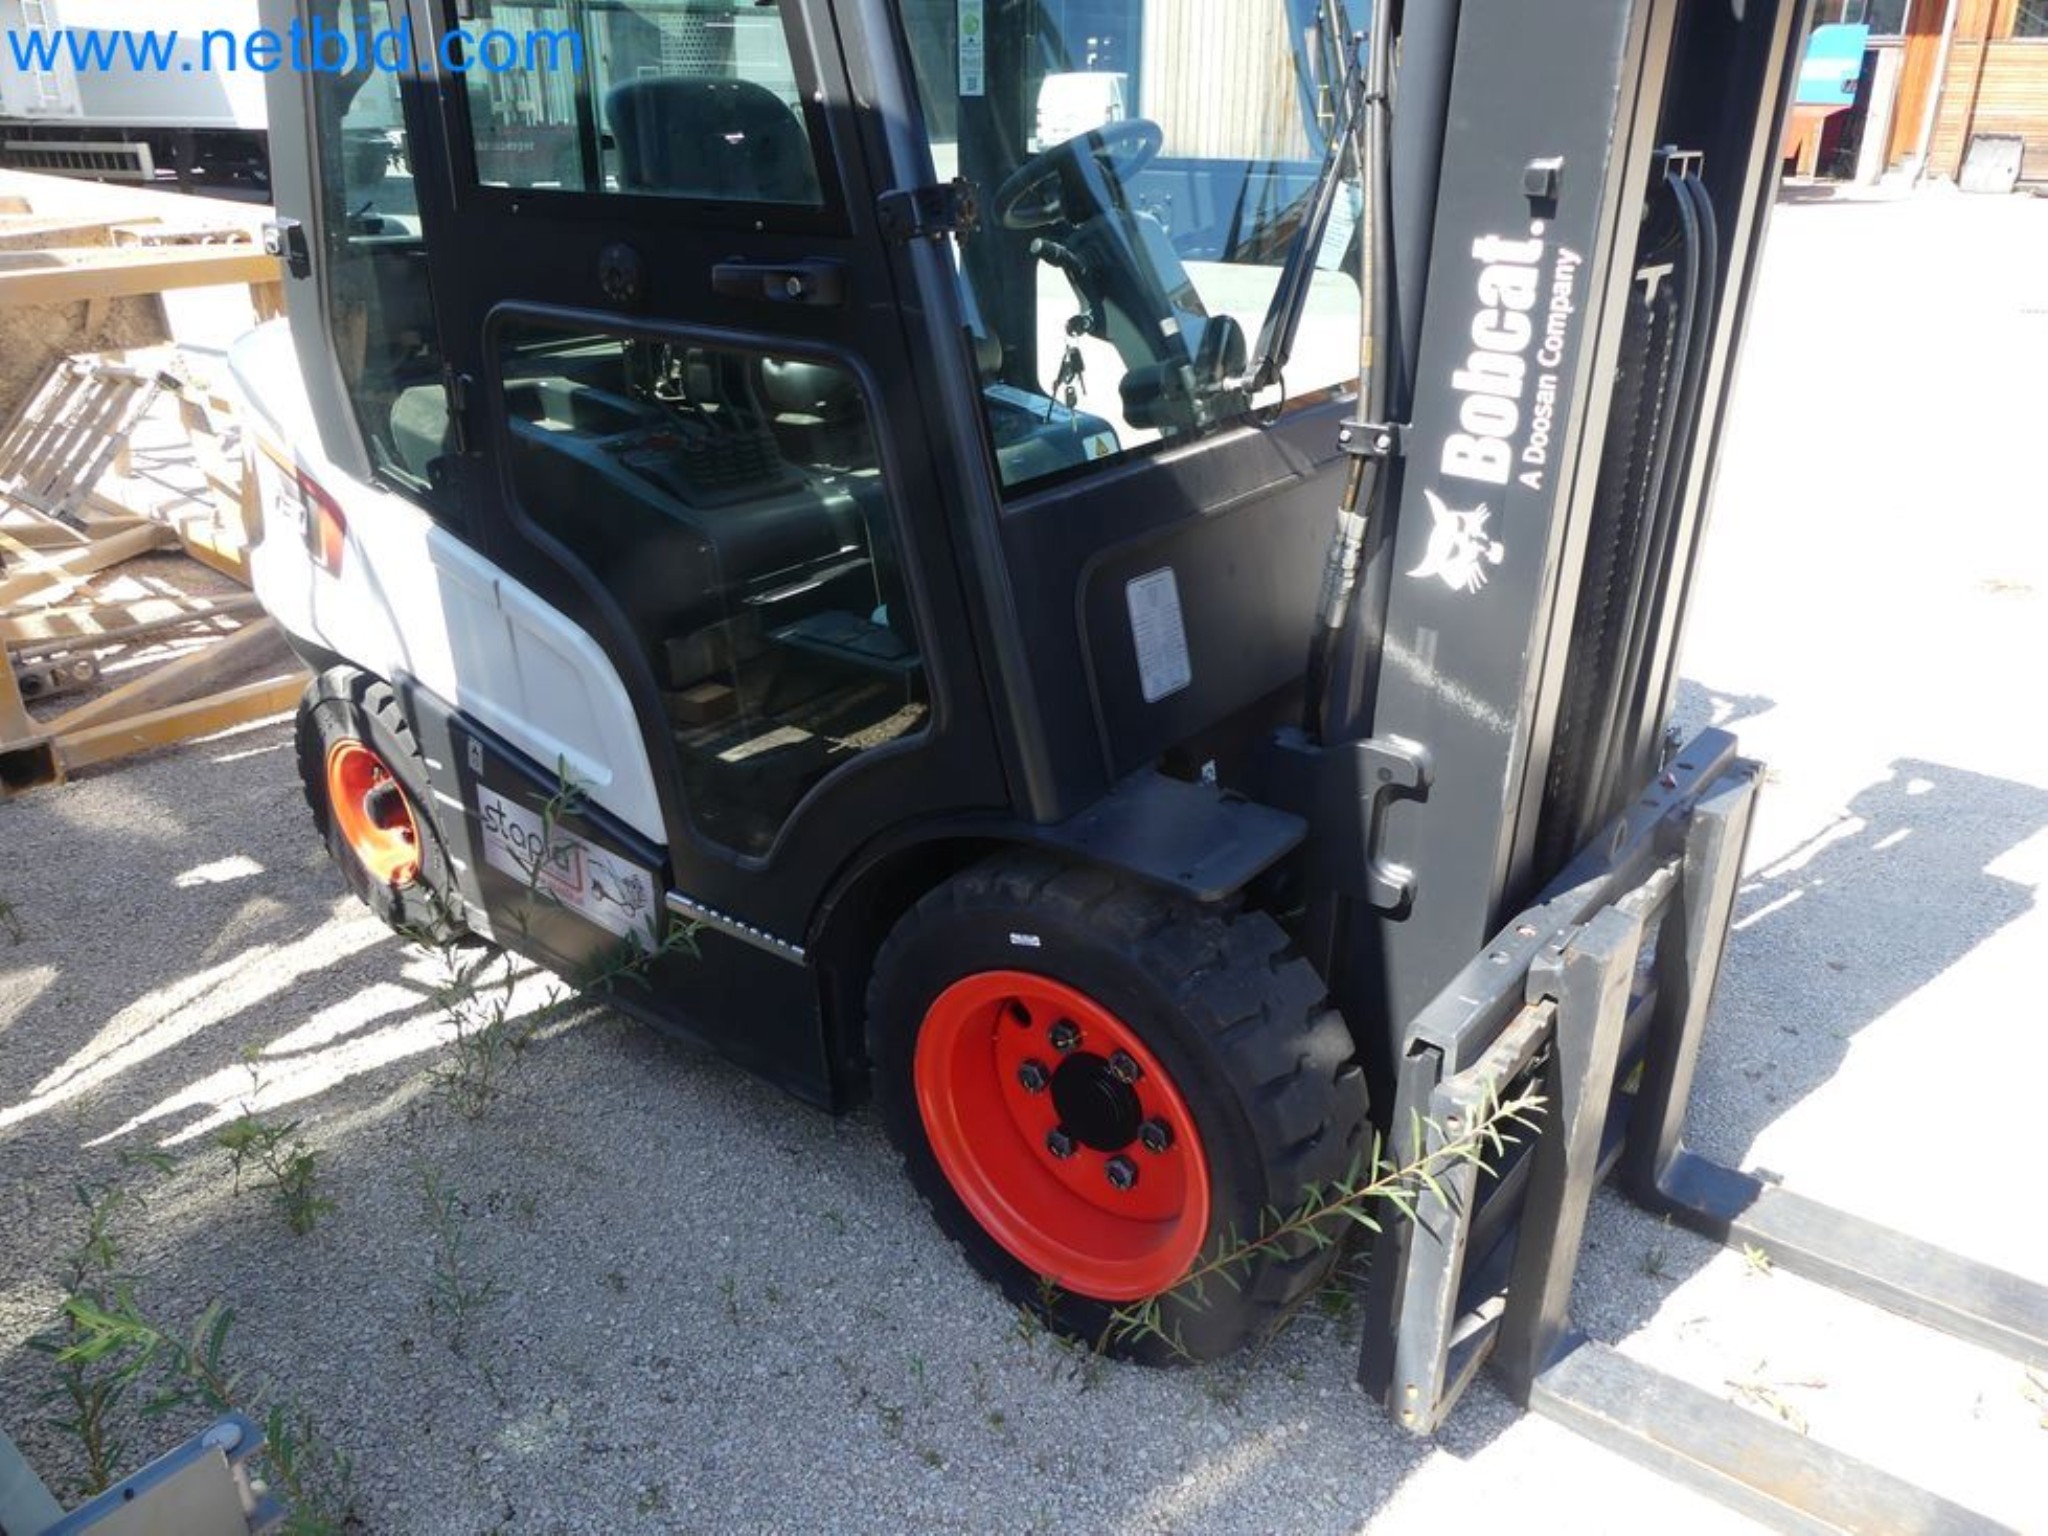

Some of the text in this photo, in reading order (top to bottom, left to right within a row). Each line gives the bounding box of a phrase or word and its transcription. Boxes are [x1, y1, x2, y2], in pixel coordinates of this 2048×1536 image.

[1519, 247, 1582, 490] A Doosan Company
